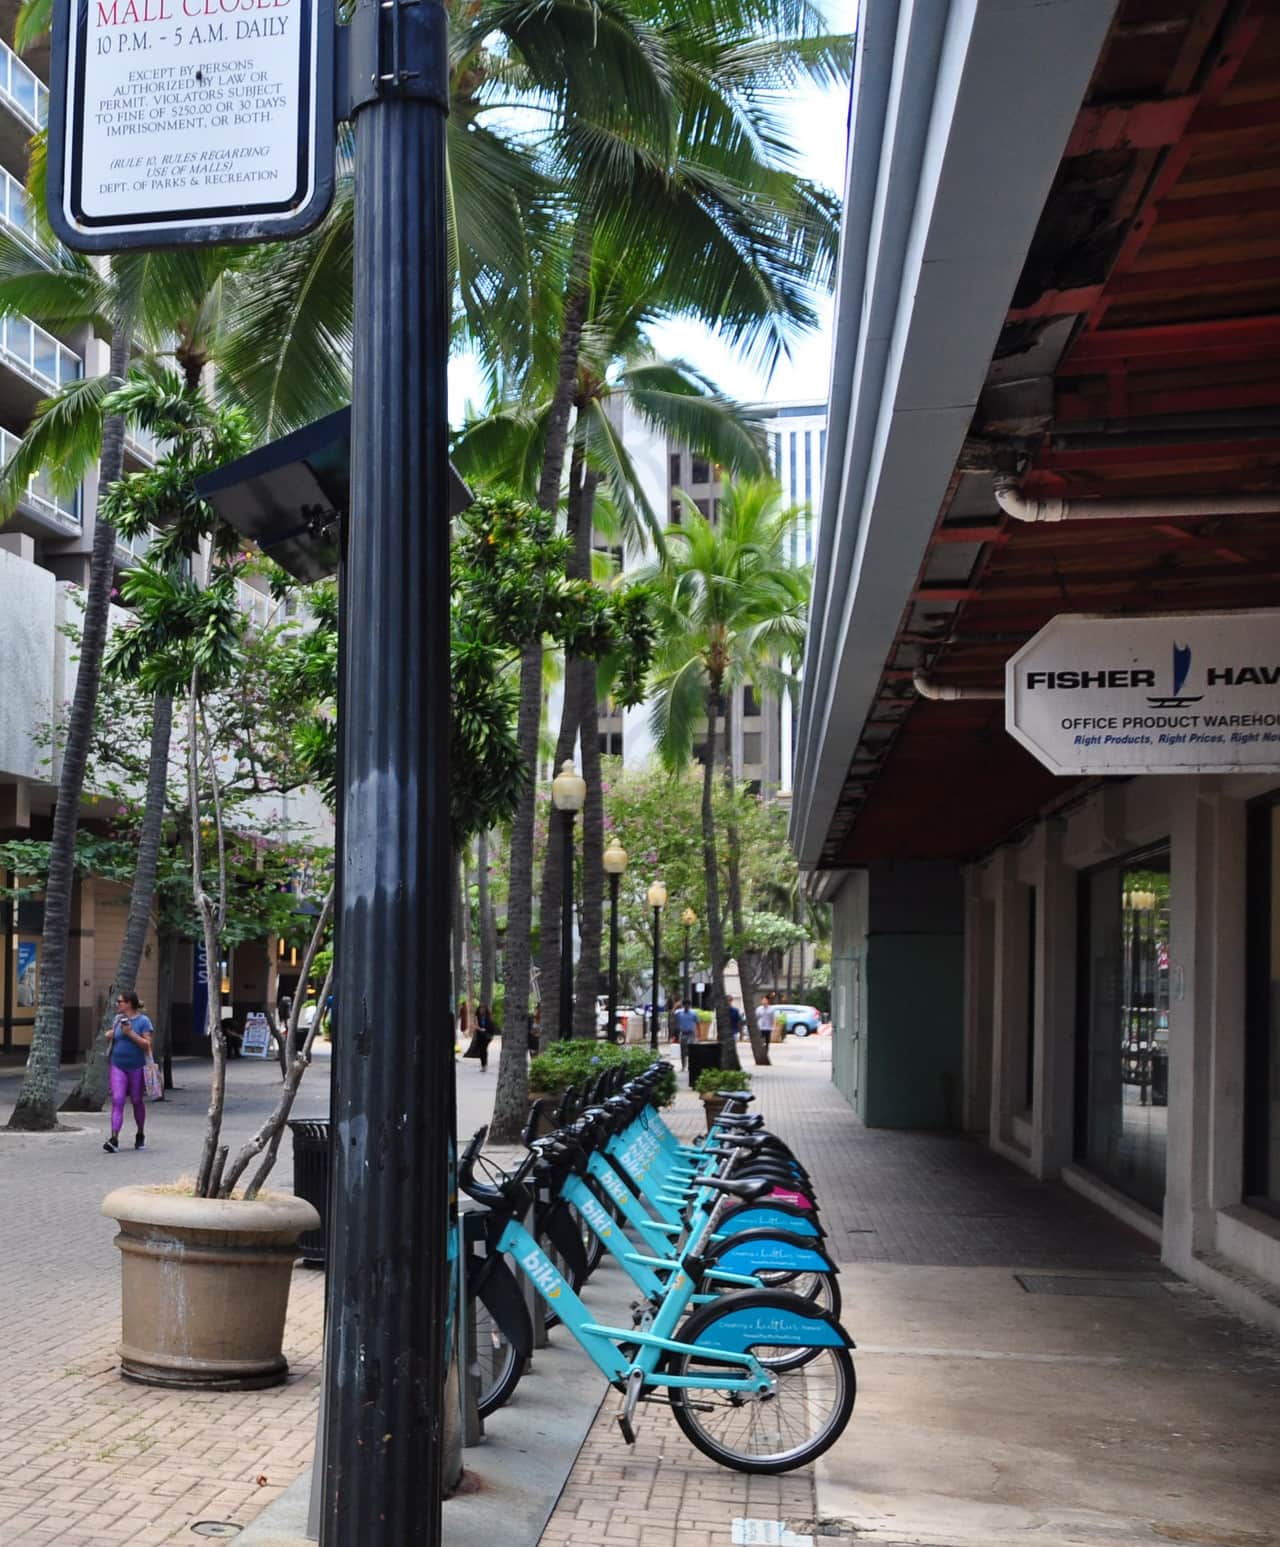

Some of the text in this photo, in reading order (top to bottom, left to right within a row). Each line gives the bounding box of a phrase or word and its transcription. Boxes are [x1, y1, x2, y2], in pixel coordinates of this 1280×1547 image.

[96, 0, 291, 27] MALL CLO
[97, 36, 112, 55] 10
[118, 32, 152, 52] P.M.
[174, 27, 182, 46] 5
[189, 24, 228, 45] A.M.
[236, 16, 289, 40] DAILY
[128, 59, 254, 82] EXCEPT BY PERSONS
[113, 71, 268, 96] AUTHORIZED BY LAW OR
[154, 88, 224, 105] VIOLATORS
[228, 83, 283, 98] SUBJECT
[96, 113, 113, 125] TO
[117, 109, 145, 122] FINE
[149, 107, 166, 119] OF
[215, 101, 233, 112] OR
[240, 99, 251, 110] 30
[255, 96, 287, 109] DAYS
[211, 114, 229, 127] OR
[234, 111, 273, 125] BOTH.
[110, 156, 143, 170] (RULE
[161, 152, 198, 165] RULES
[200, 146, 271, 161] REGARDING
[146, 160, 234, 177] USE OF MALLS)
[99, 169, 278, 194] DEPT. OF PARKS & RECREATION
[1026, 669, 1156, 689] FISHER
[1061, 714, 1280, 730] OFFICE PRODUCT WAREHO
[1073, 734, 1102, 746] Right
[1104, 734, 1153, 745] Products,
[1158, 733, 1186, 745] Right
[1188, 732, 1226, 744] Prices,
[1230, 731, 1261, 744] Right
[601, 1171, 627, 1198] biki
[581, 1199, 612, 1232] biki
[522, 1249, 560, 1292] biki
